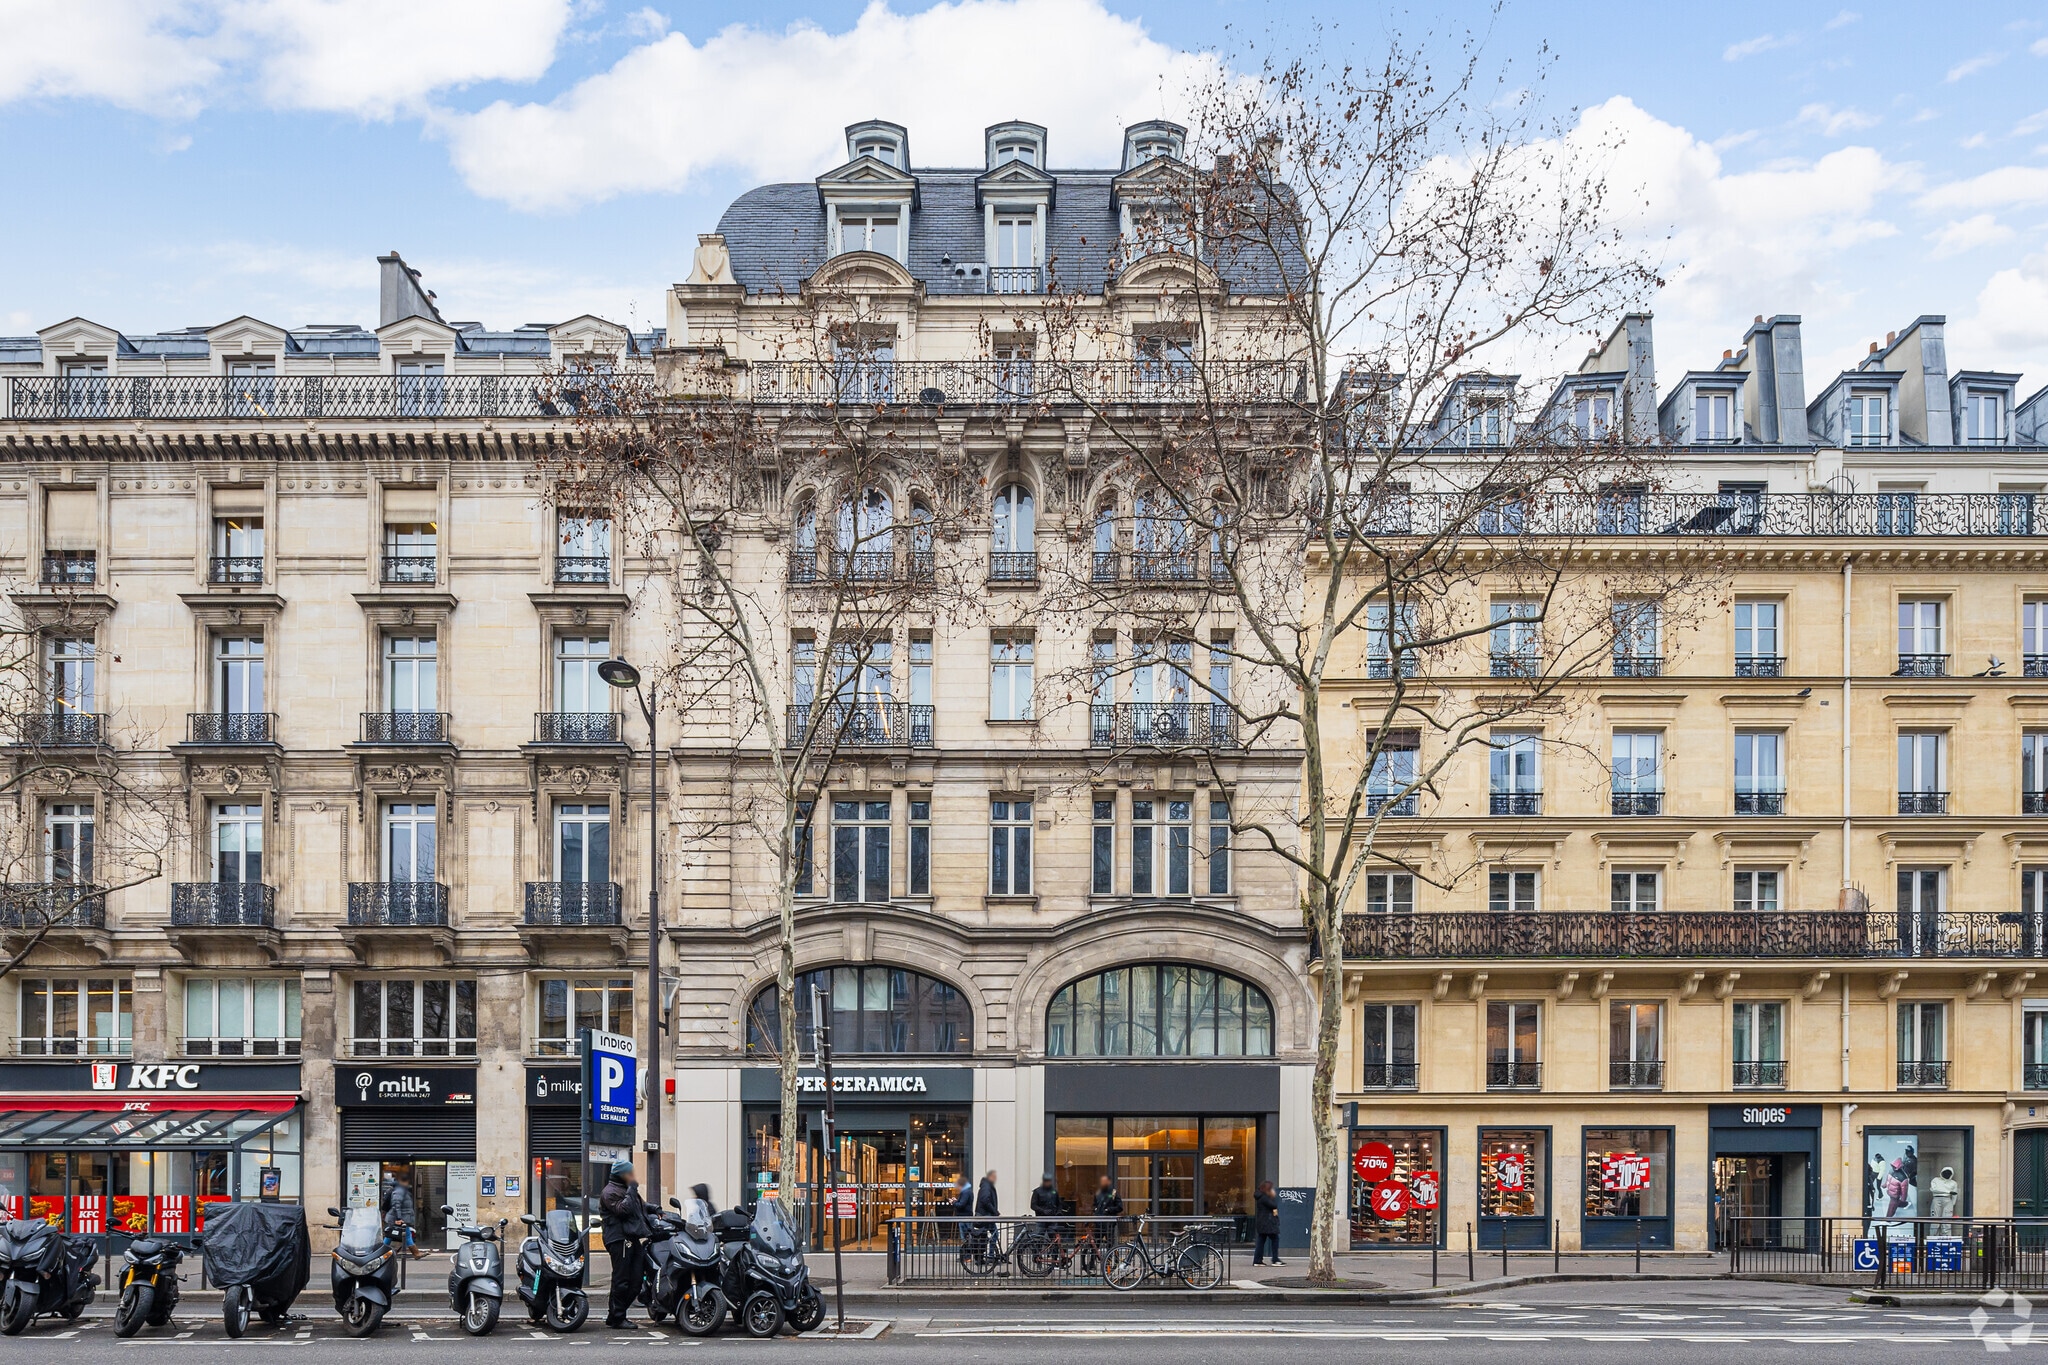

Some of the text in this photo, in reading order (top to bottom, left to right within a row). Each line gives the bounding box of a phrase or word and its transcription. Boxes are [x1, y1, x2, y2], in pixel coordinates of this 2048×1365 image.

[600, 1036, 632, 1052] INDIGO
[127, 1065, 200, 1088] KFC
[601, 1057, 624, 1102] P
[379, 1076, 430, 1092] milk
[795, 1077, 927, 1092] PER CERAMICA
[122, 1102, 150, 1111] KFC
[600, 1104, 630, 1115] SÉBASTOPOL
[610, 1114, 627, 1122] HALLES
[1743, 1108, 1786, 1125] snipes
[1358, 1158, 1388, 1169] -70%
[78, 1210, 100, 1218] KFC
[161, 1210, 183, 1218] KFC
